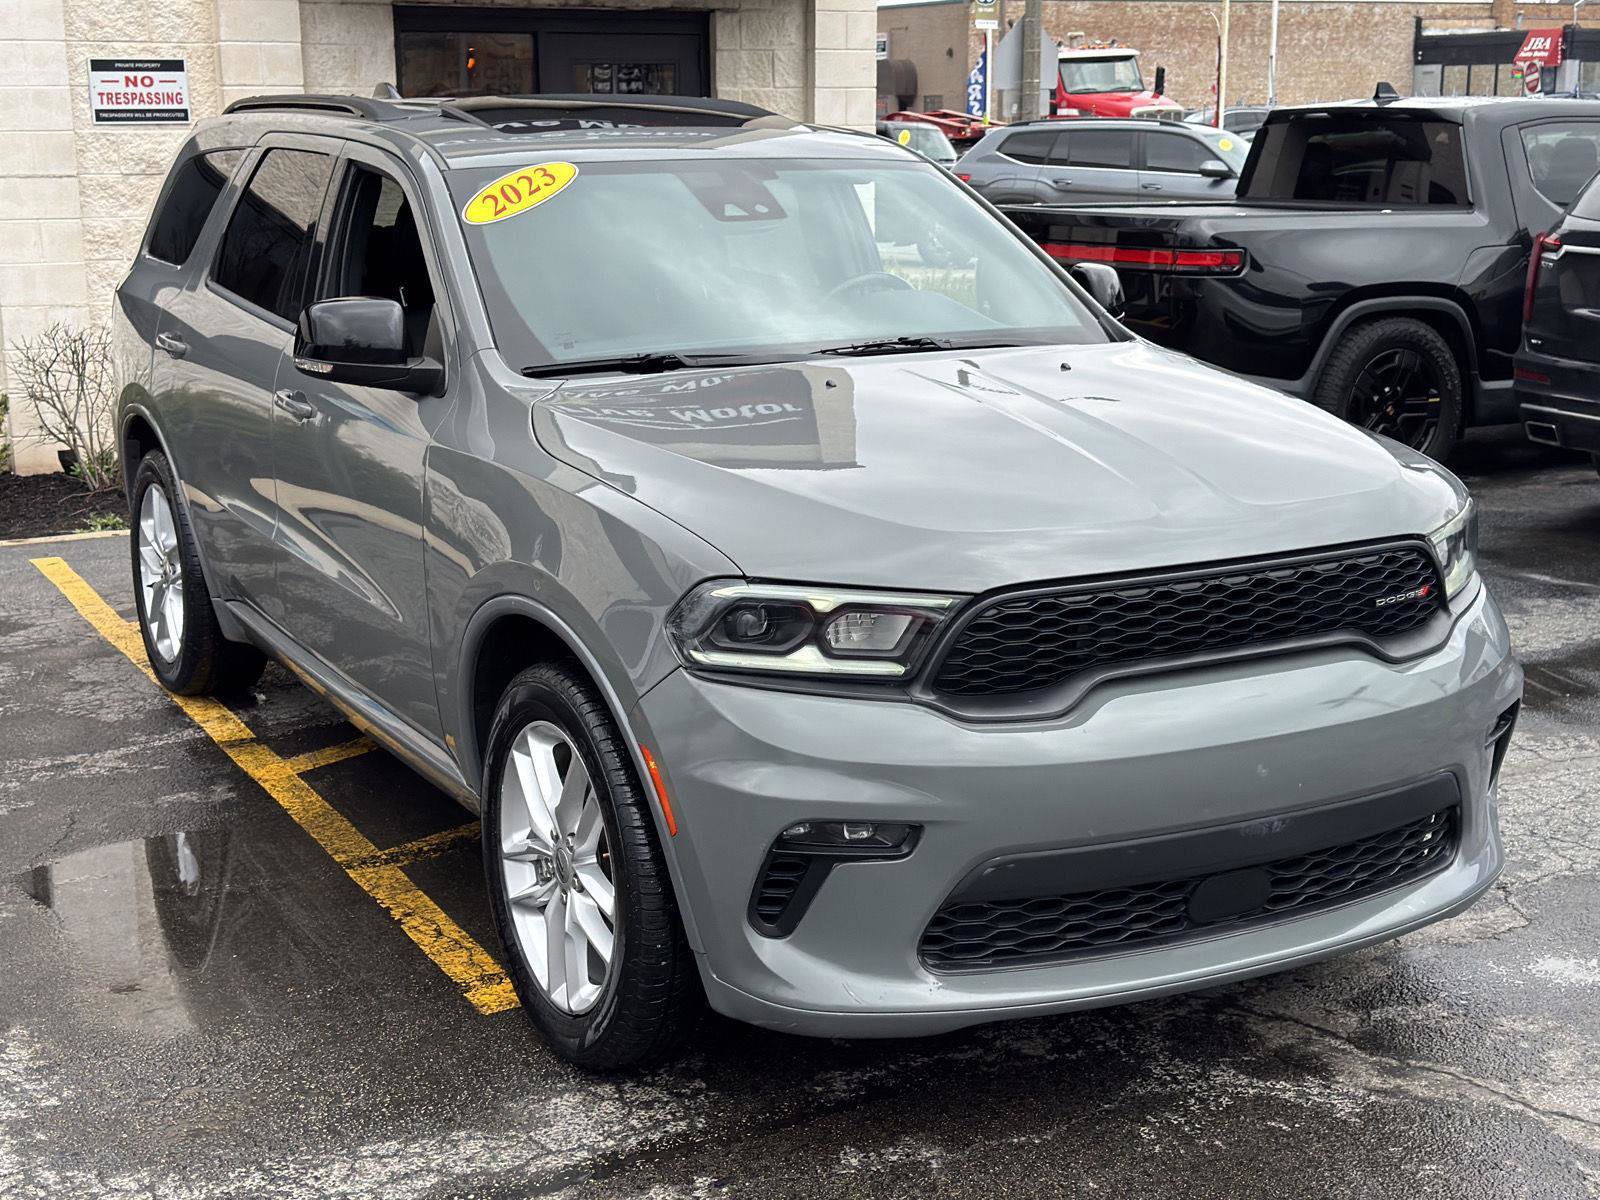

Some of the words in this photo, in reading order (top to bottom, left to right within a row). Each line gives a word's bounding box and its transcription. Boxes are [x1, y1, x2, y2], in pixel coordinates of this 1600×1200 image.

[1523, 36, 1552, 51] JBA
[124, 75, 154, 88] NO
[97, 92, 184, 105] TRESPASSING
[482, 167, 556, 217] 2023
[1376, 588, 1424, 606] DODGE
